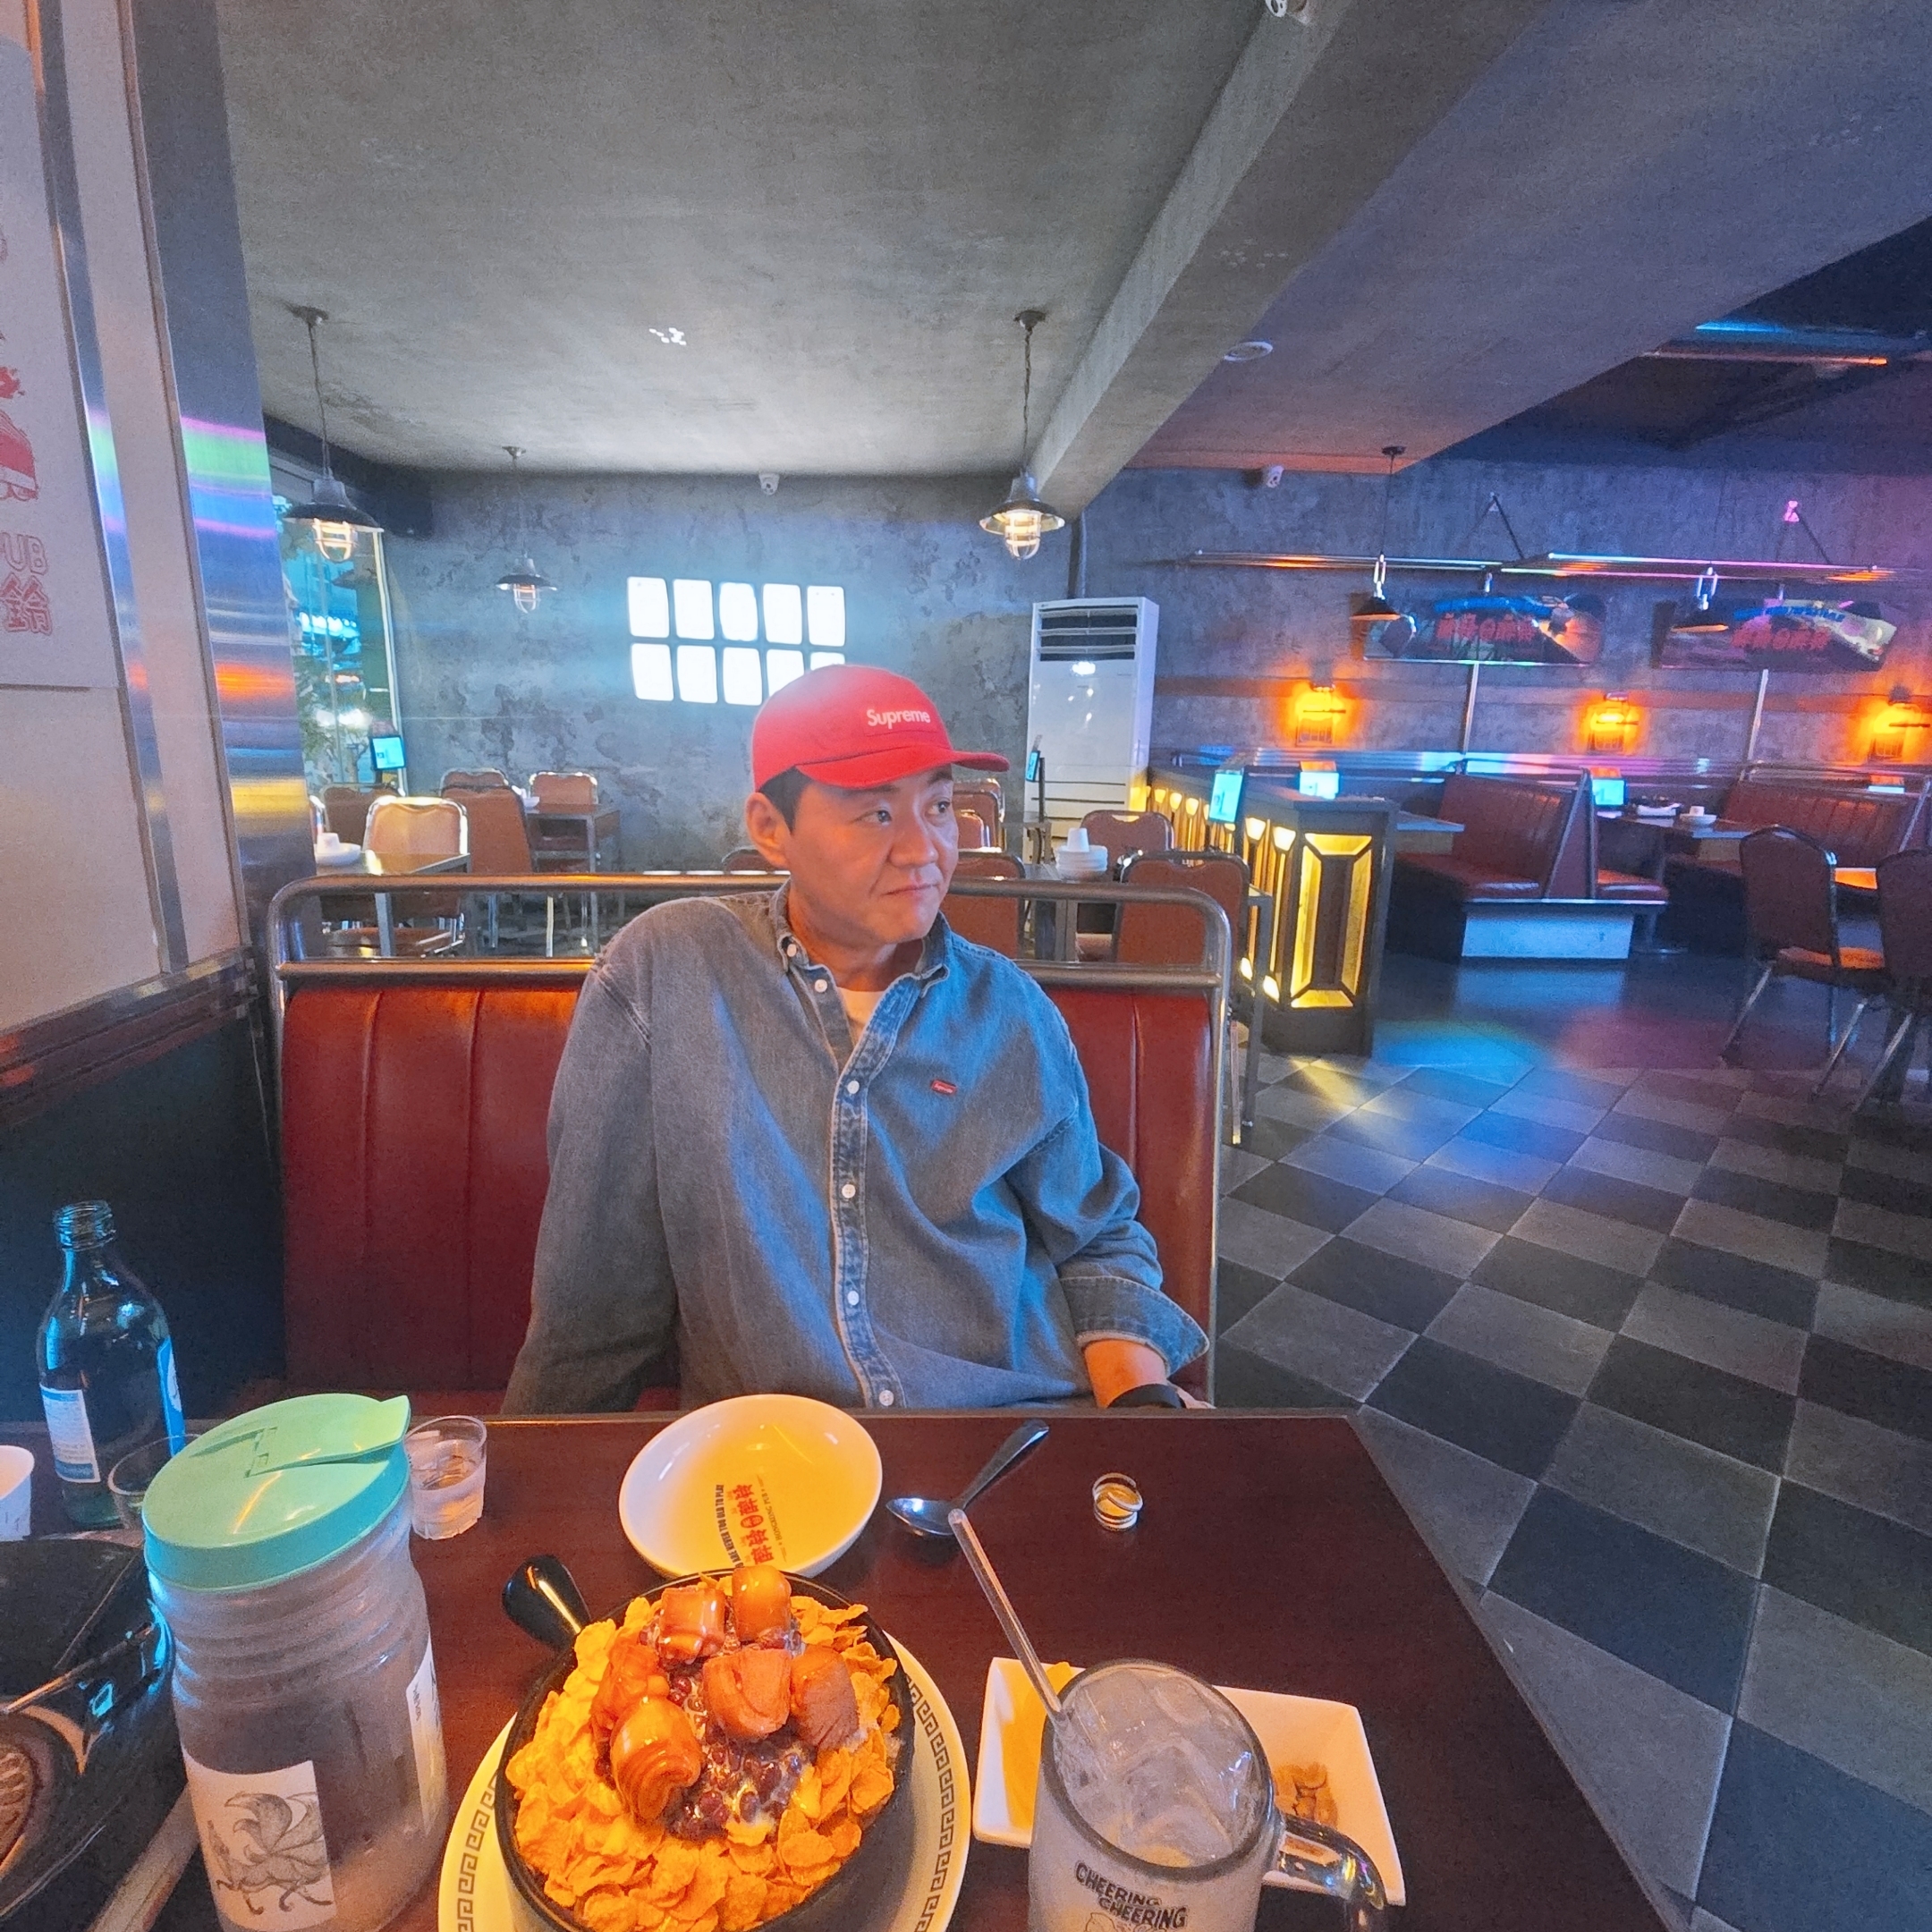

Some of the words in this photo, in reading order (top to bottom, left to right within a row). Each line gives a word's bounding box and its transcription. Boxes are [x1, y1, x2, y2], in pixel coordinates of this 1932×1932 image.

[0, 532, 47, 576] UB
[866, 708, 931, 730] Supreme
[716, 1484, 724, 1498] PLAY
[760, 1492, 771, 1505] PUB
[716, 1497, 724, 1507] TO
[716, 1506, 725, 1519] OLD
[717, 1519, 728, 1532] TOO
[764, 1506, 783, 1541] HONGKONG
[720, 1530, 734, 1552] NEVER
[728, 1550, 741, 1563] ARE
[1075, 1861, 1162, 1906] CHEERING
[1098, 1896, 1188, 1928] CHEERING
